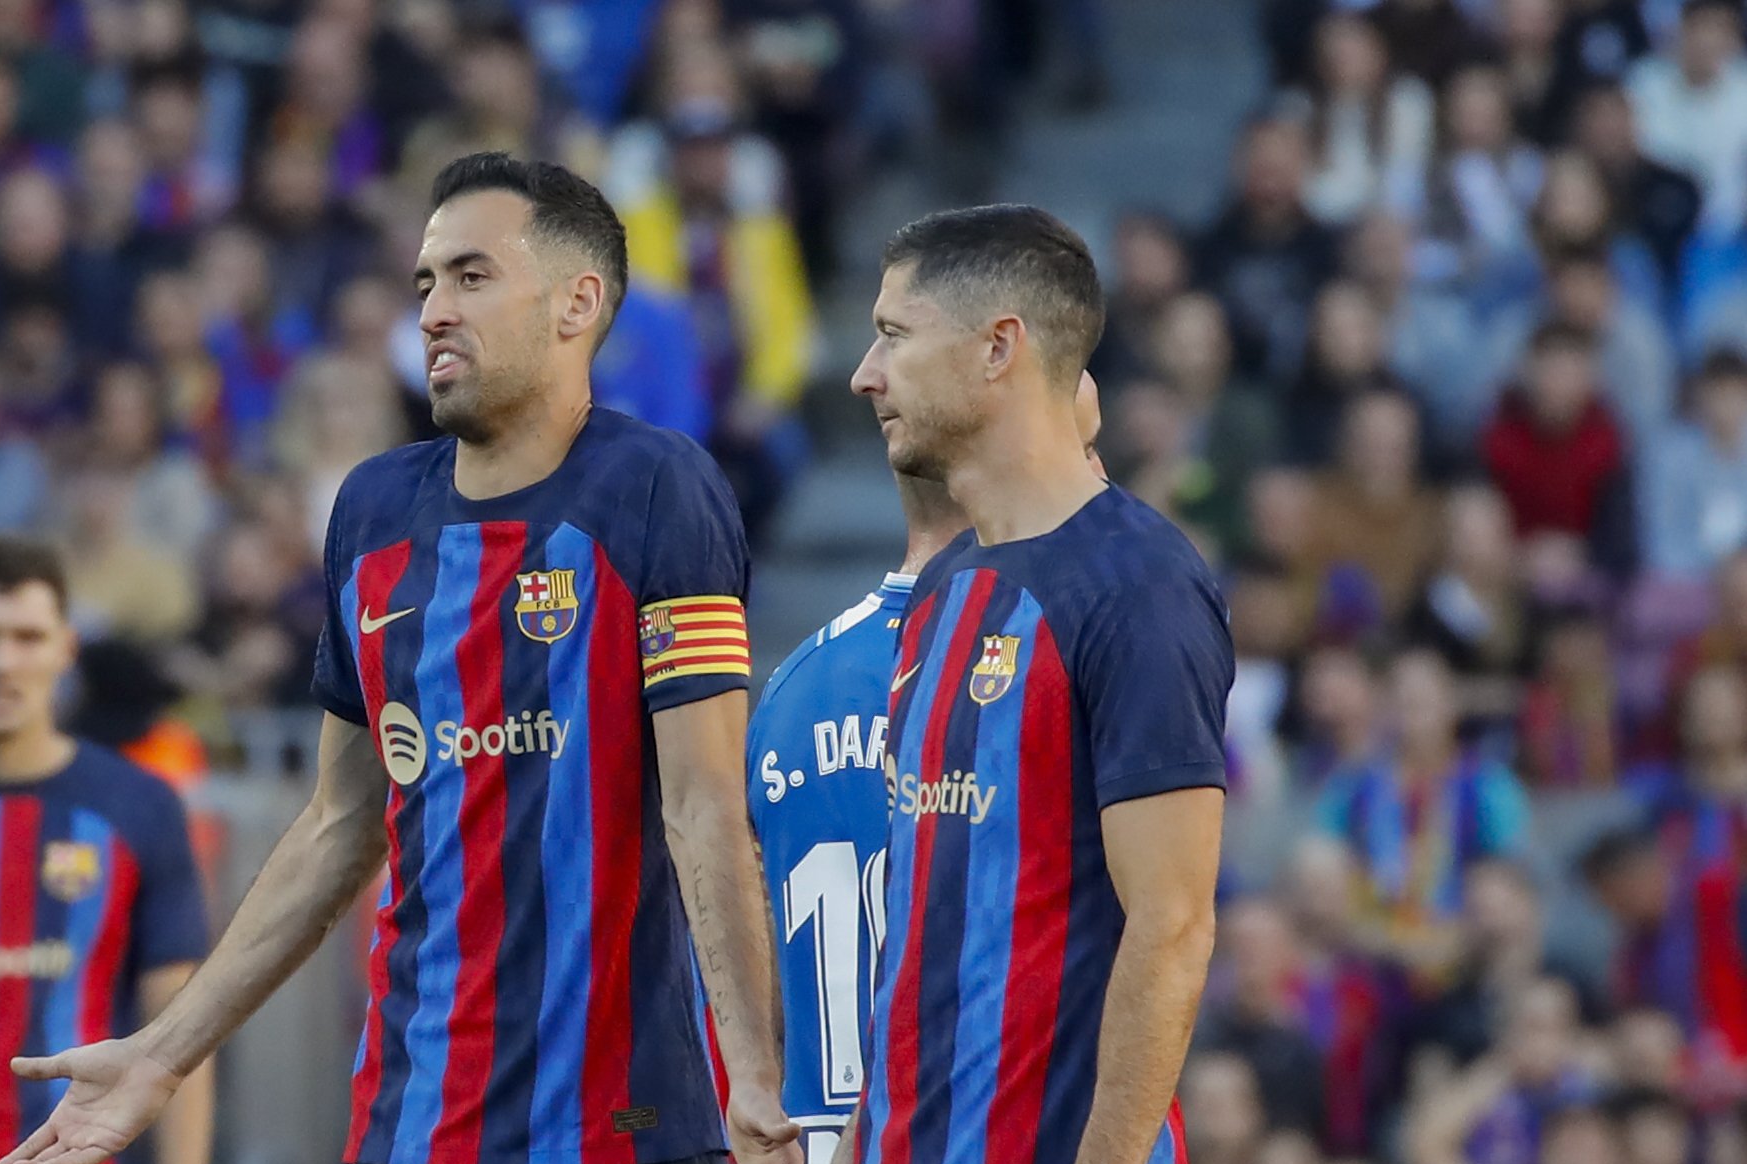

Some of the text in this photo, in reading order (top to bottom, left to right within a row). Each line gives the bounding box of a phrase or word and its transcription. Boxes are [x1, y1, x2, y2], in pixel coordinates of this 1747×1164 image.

[434, 709, 570, 767] Spotify
[761, 750, 805, 803] S.
[899, 768, 998, 824] Spotify
